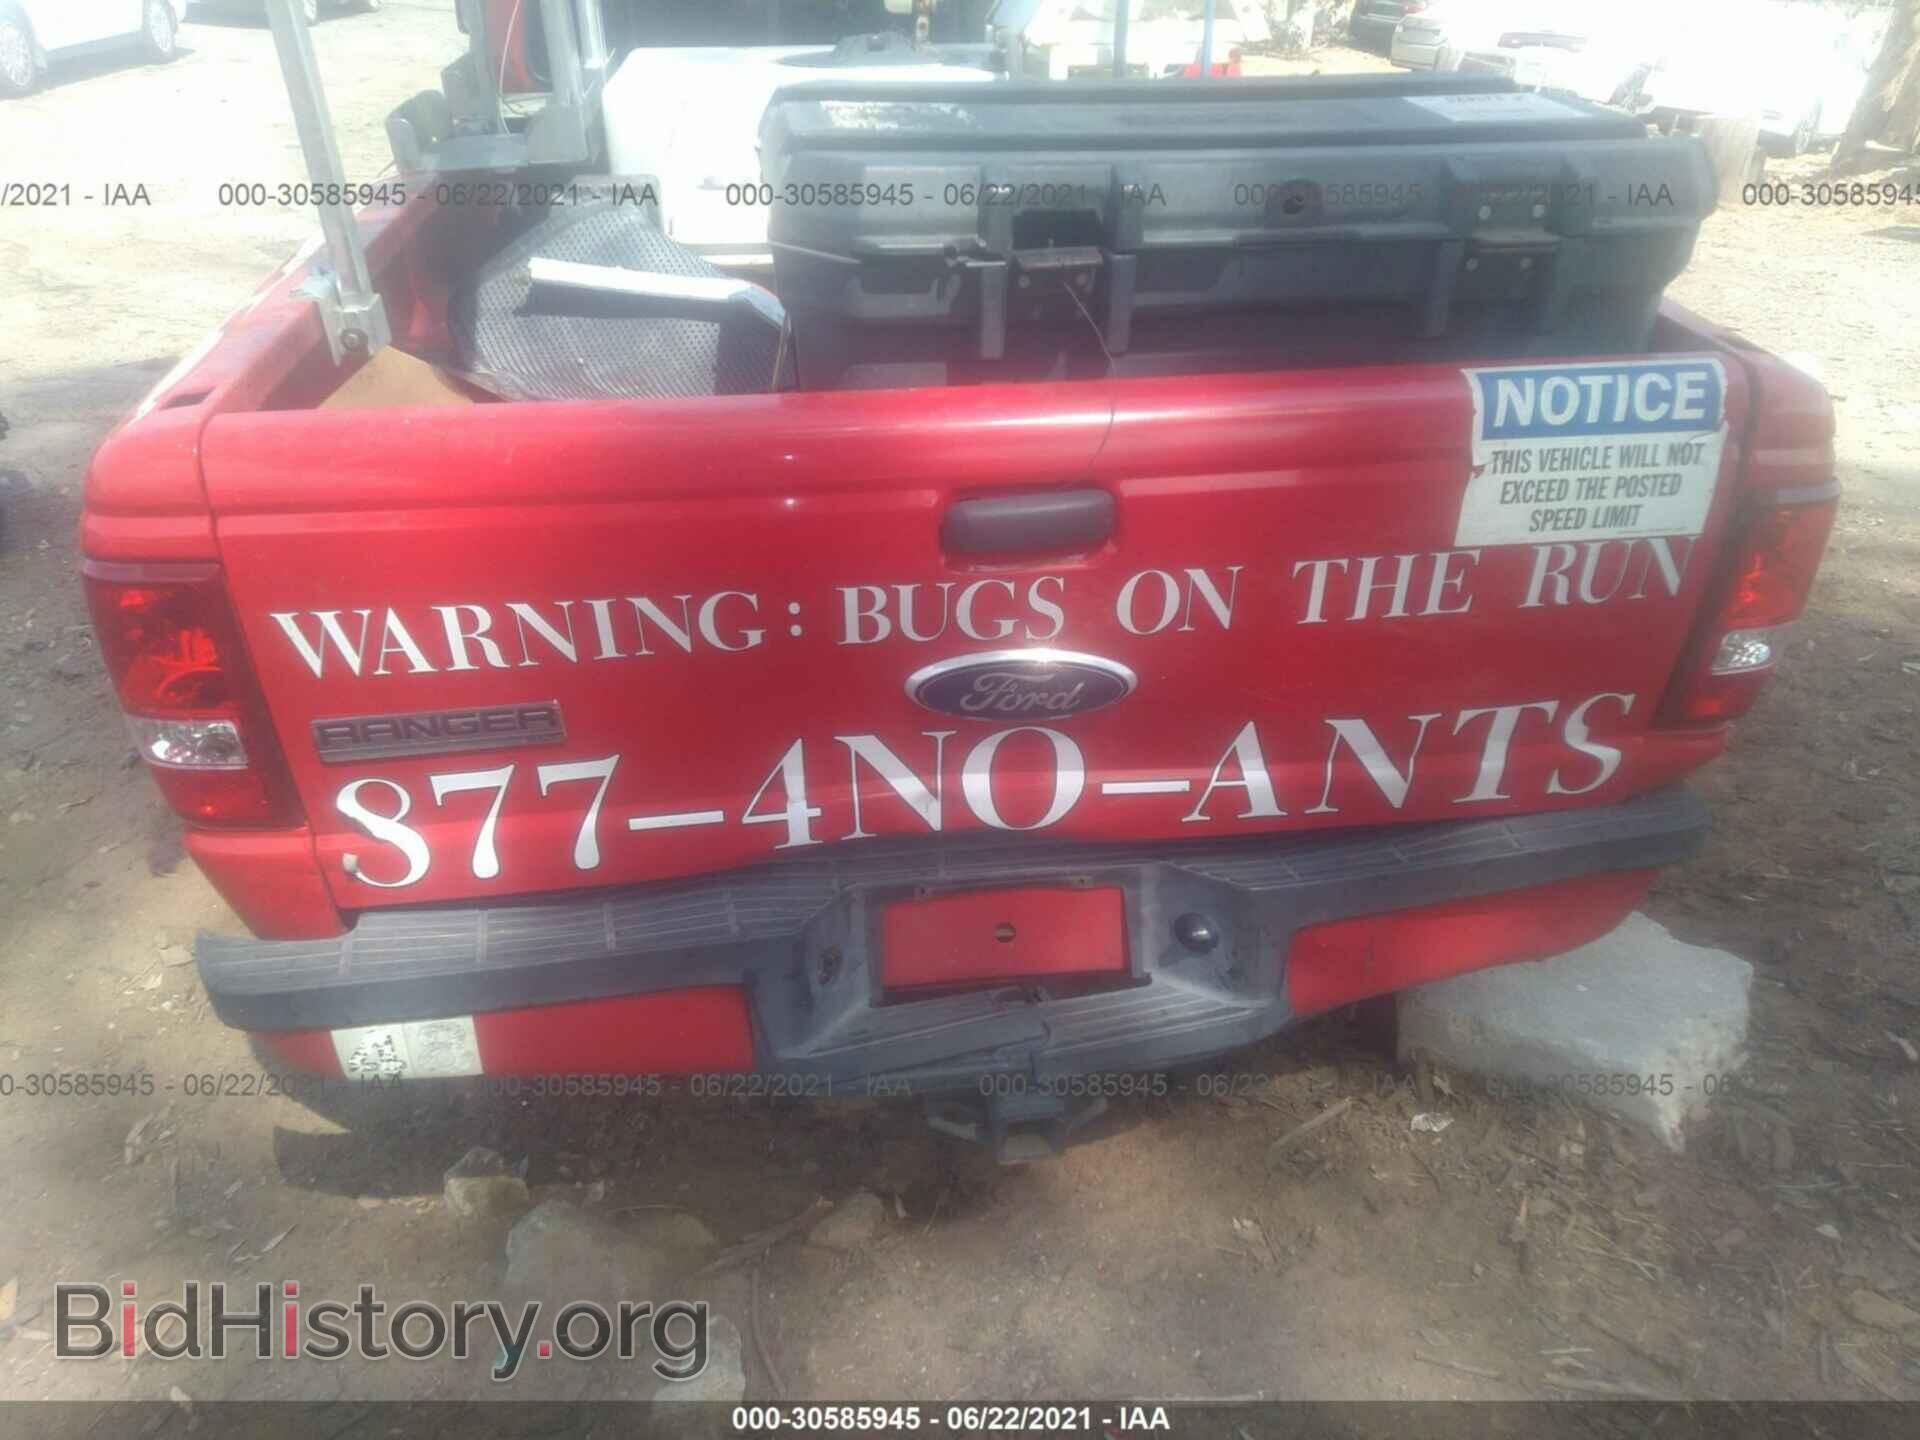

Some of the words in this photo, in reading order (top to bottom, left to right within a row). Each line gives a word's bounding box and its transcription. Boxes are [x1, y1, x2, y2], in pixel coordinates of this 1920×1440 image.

[1493, 371, 1708, 427] NOTICE
[1491, 449, 1532, 475] THIS
[1538, 446, 1612, 472] VEHICLE
[1618, 443, 1661, 469] WILL
[1666, 442, 1706, 467] NOT
[1500, 477, 1570, 505] EXCEED
[1576, 476, 1611, 501] THE
[1614, 473, 1682, 499] POSTED
[1529, 507, 1587, 533] SPEED
[1592, 504, 1644, 529] LIMIT
[836, 576, 1065, 645] BUGS
[1116, 566, 1243, 638] ON
[1292, 548, 1481, 624] THE
[1519, 534, 1698, 609] RUN
[960, 672, 1086, 712] Ford
[318, 707, 559, 749] RANGER
